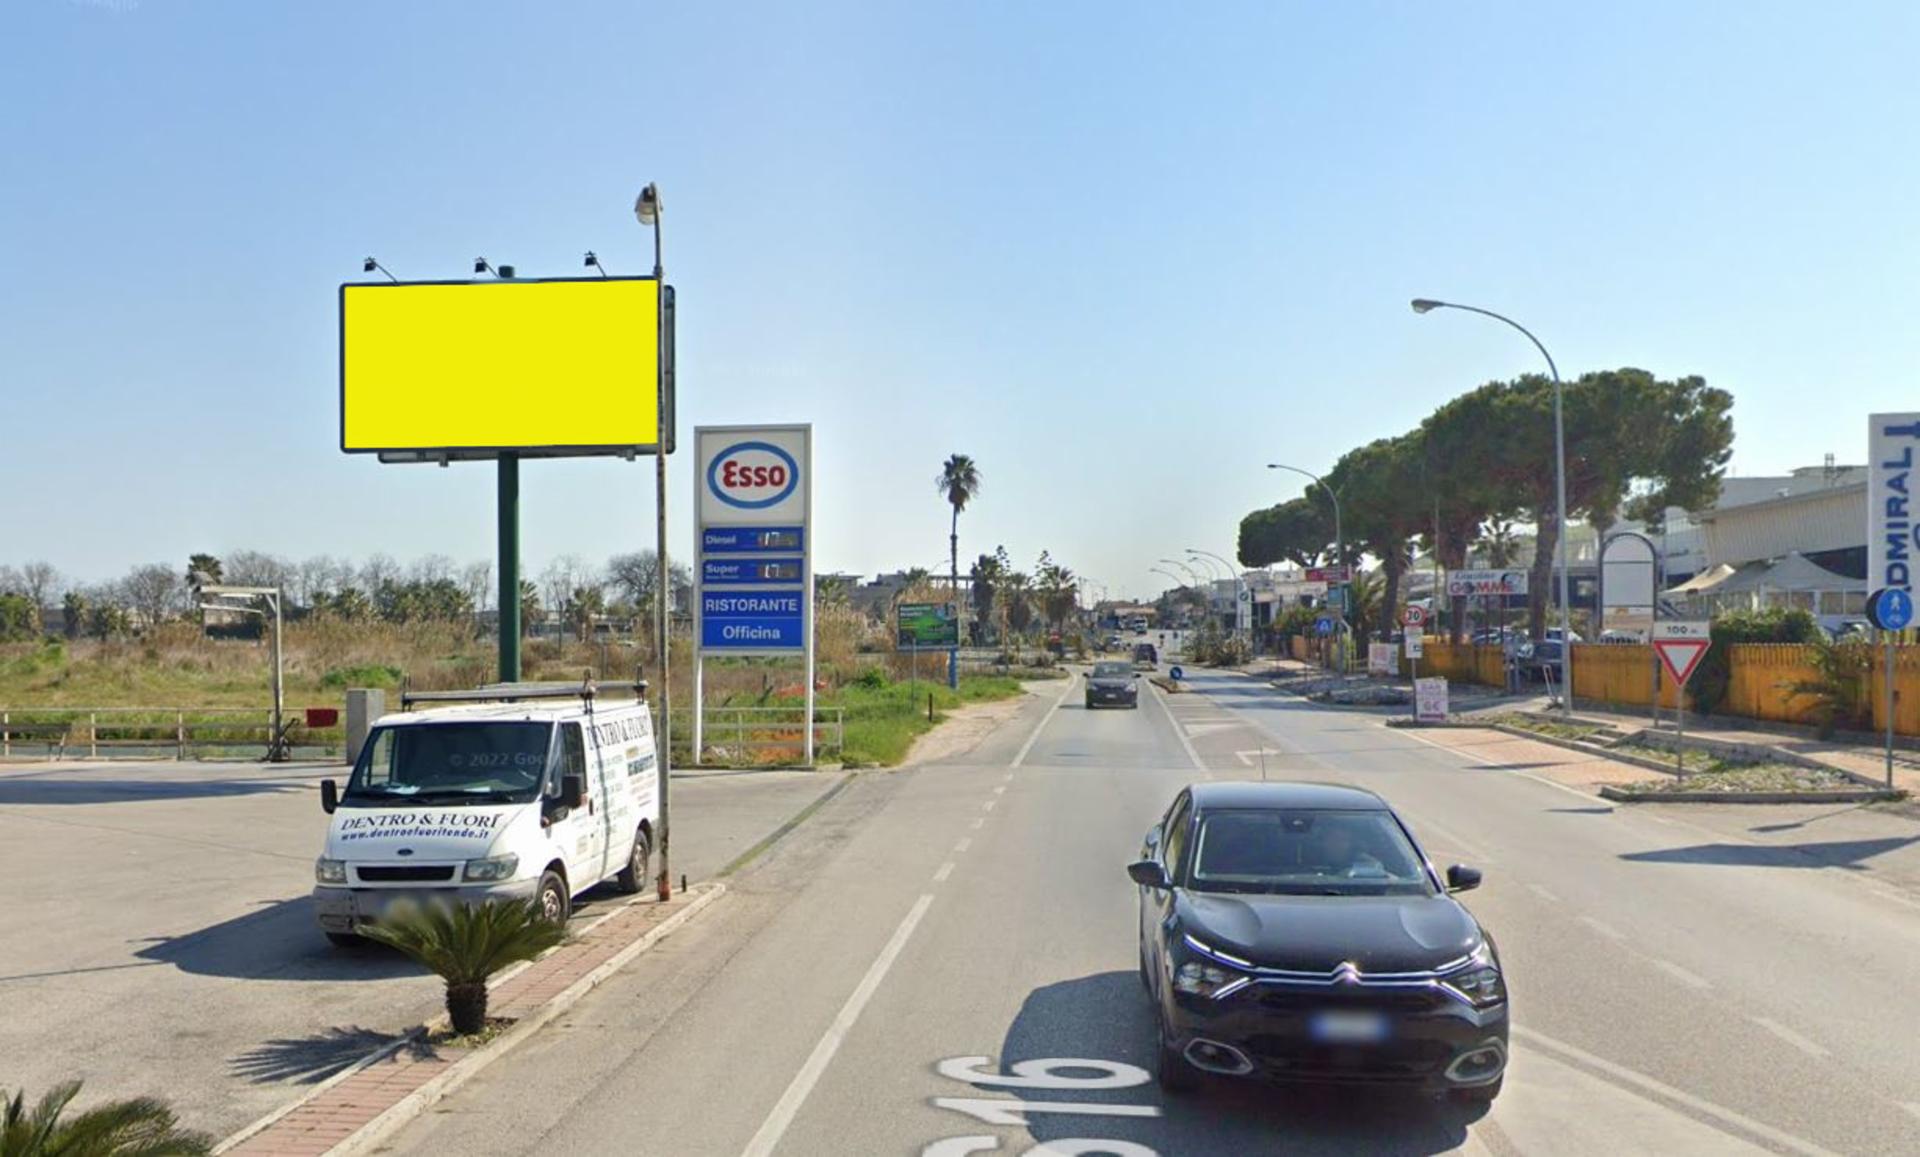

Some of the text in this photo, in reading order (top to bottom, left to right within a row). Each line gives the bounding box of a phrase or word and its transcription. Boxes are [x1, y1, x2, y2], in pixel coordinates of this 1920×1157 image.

[1882, 447, 1912, 592] DMIRAL
[705, 564, 740, 575] Super
[705, 599, 798, 612] RISTORANTE
[722, 626, 781, 640] Officina
[1666, 626, 1688, 634] 100
[341, 812, 504, 831] DENTRO & FUORI
